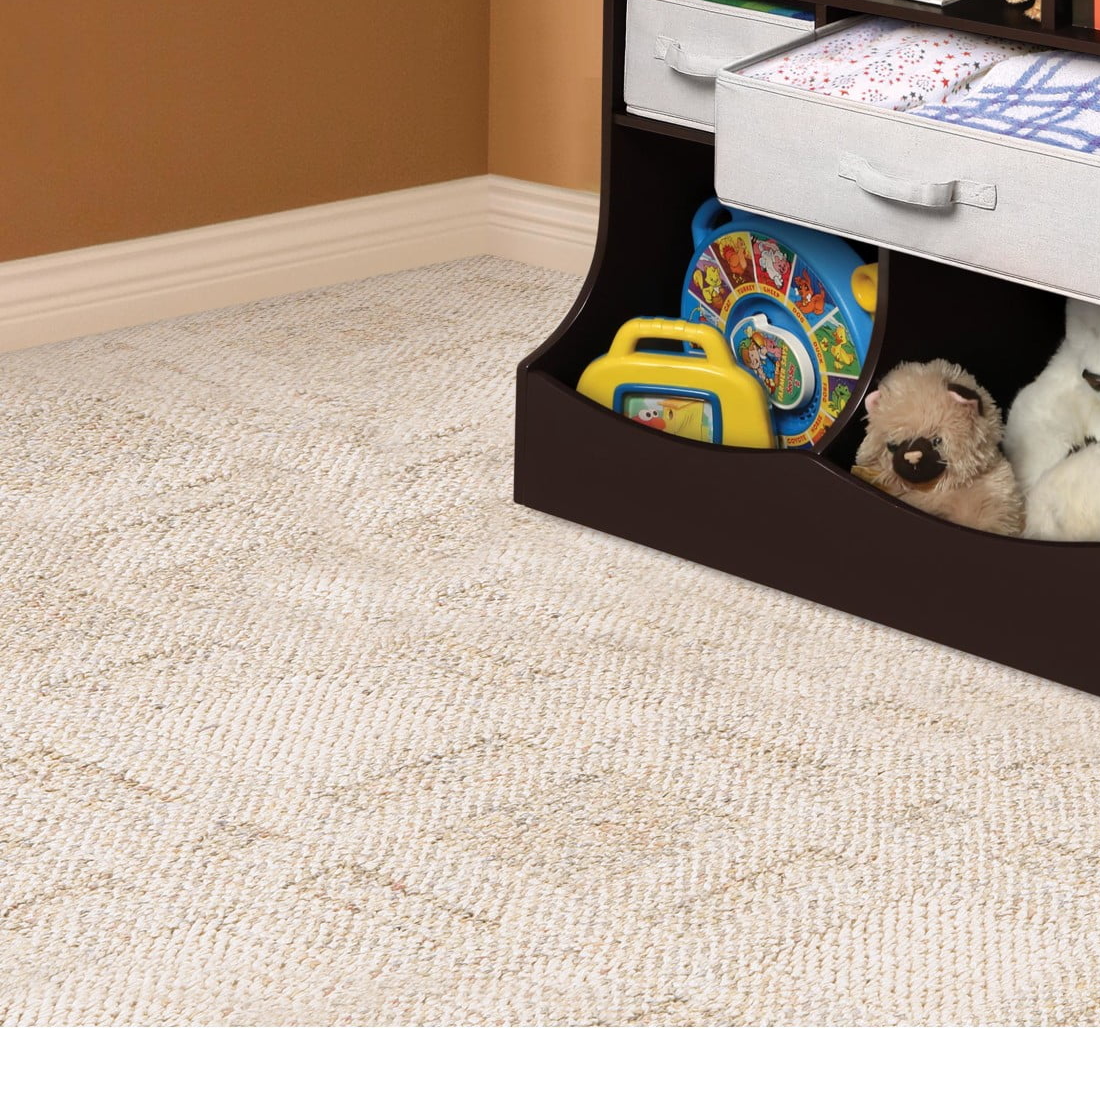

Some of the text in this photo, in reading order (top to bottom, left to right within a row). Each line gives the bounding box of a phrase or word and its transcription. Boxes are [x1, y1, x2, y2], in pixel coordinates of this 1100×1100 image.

[737, 285, 756, 295] TURKEY
[763, 286, 781, 299] SHEEP
[723, 300, 731, 312] CAT
[792, 307, 805, 324] DOG
[813, 341, 824, 364] DUCK
[777, 367, 787, 402] FARMER
